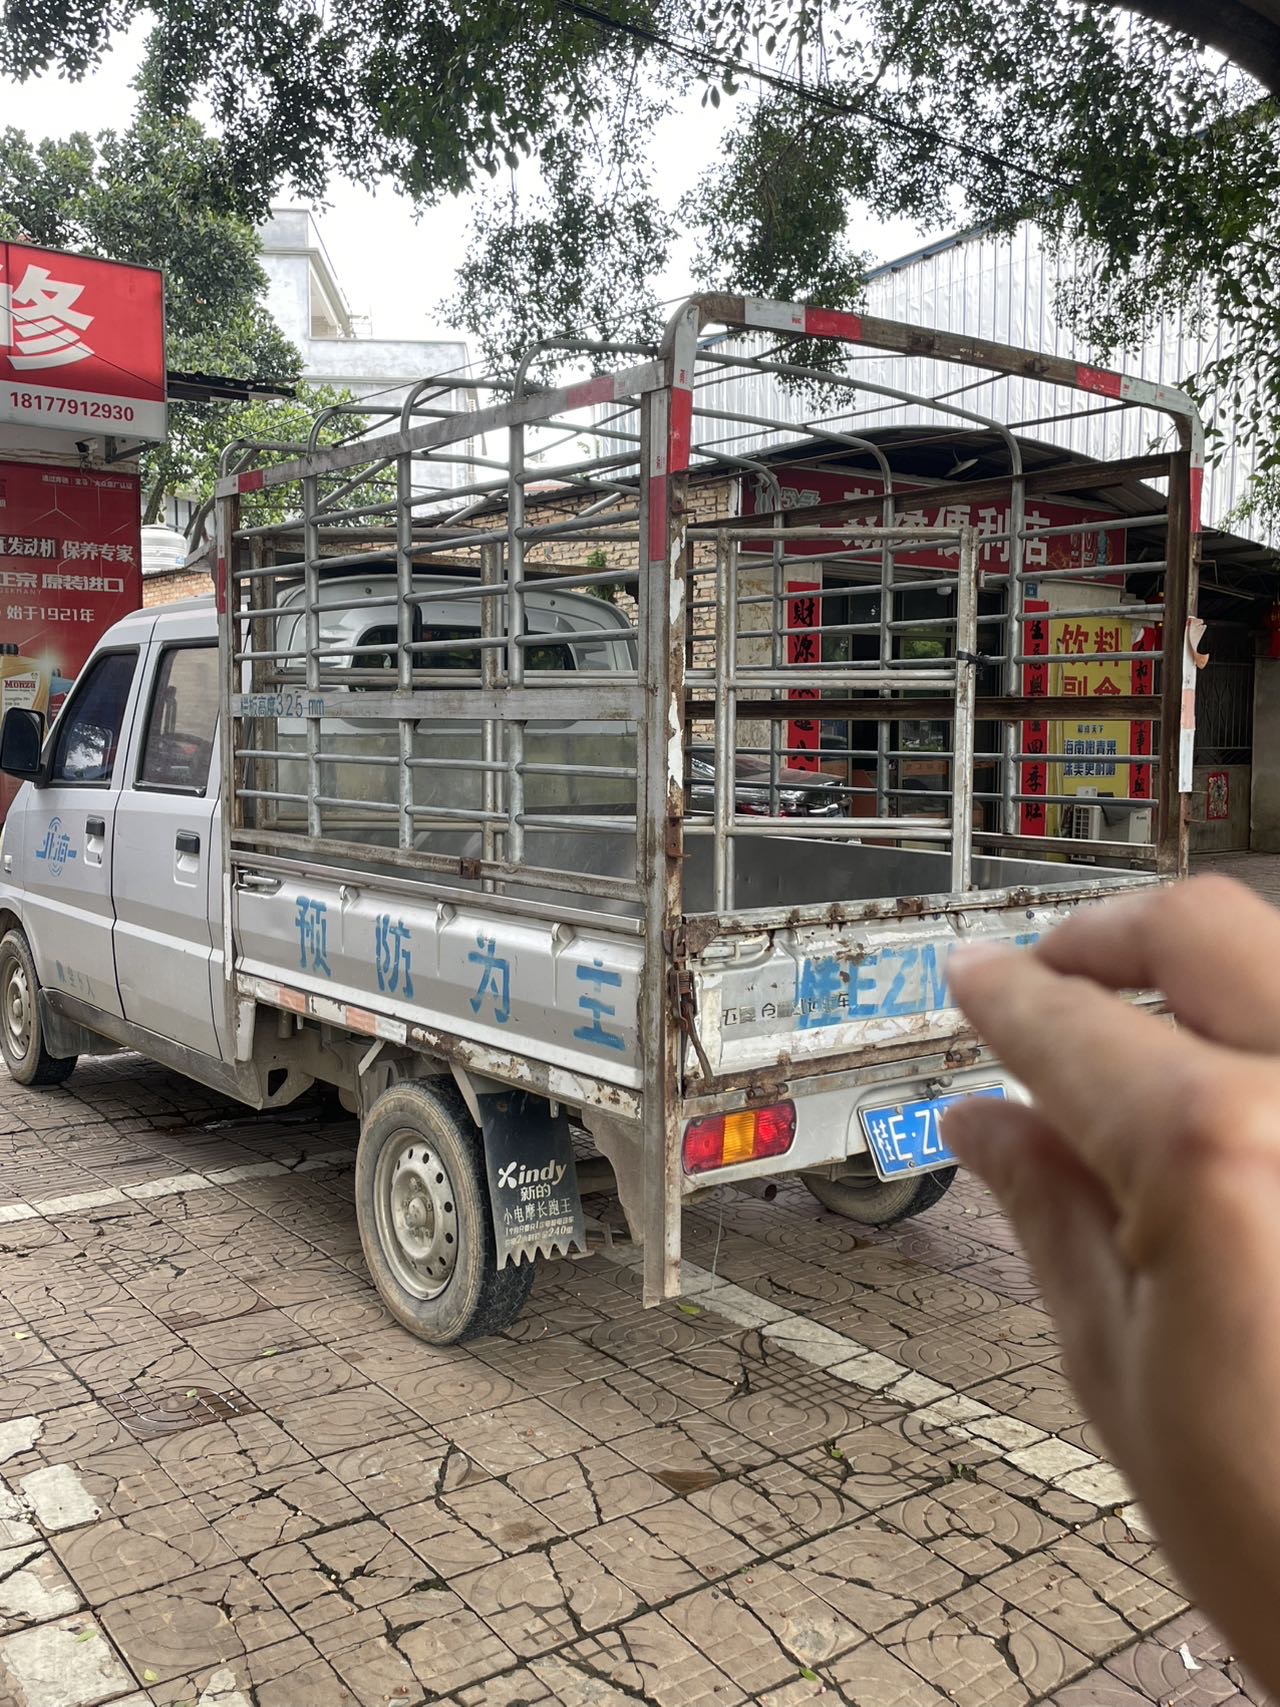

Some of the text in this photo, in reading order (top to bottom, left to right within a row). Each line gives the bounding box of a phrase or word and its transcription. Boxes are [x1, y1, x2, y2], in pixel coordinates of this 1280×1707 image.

[10, 391, 135, 422] 18177912930
[62, 540, 134, 563] 保养专家
[42, 573, 124, 593] 原装进口
[6, 604, 96, 623] 始于1921年
[1061, 623, 1122, 667] 饮料
[4, 680, 37, 689] Monza
[294, 894, 626, 1052] 预防为主
[520, 1183, 551, 1202] 新的
